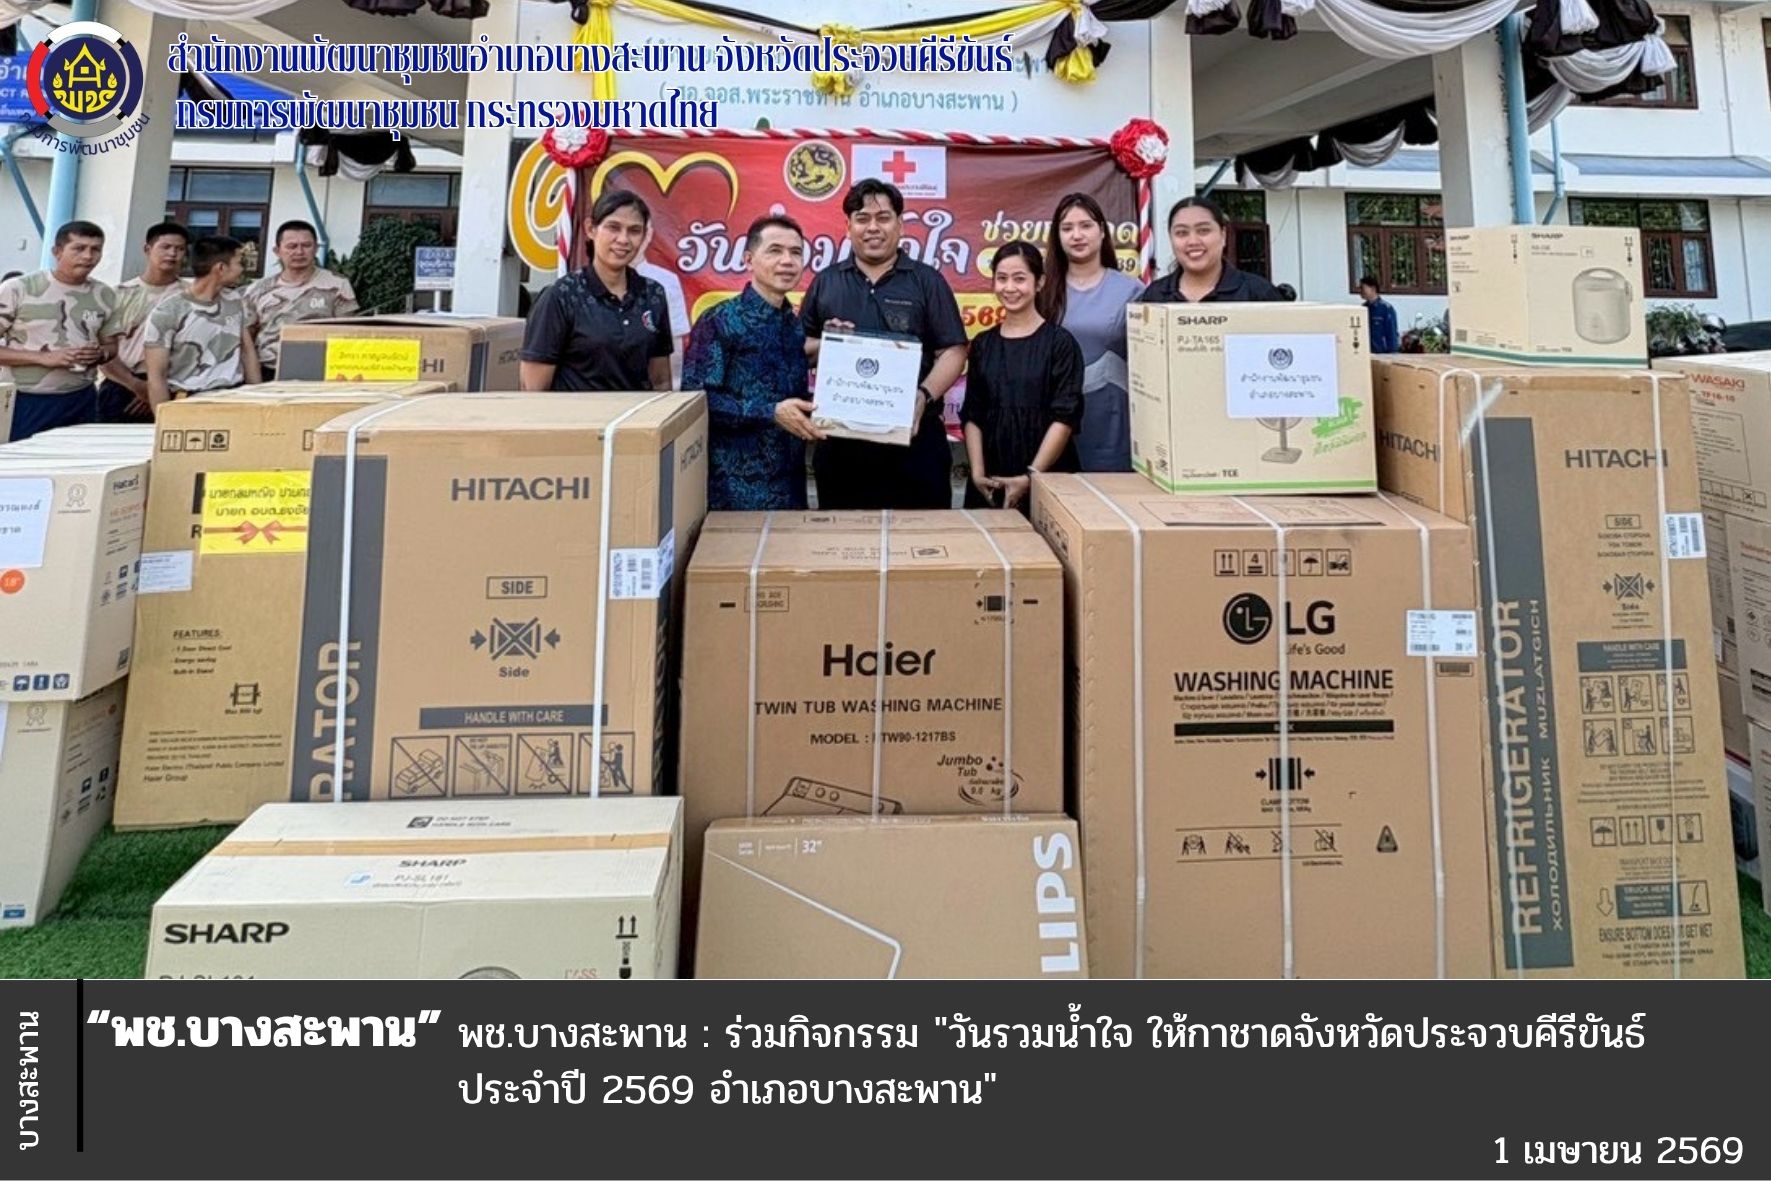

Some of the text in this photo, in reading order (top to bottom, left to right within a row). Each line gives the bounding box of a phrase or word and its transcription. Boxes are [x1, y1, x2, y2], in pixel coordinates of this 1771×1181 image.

[1177, 315, 1228, 326] SHARP
[1564, 447, 1669, 469] HITACHI
[451, 476, 590, 502] HITACHI
[501, 580, 534, 595] SIDE
[1285, 600, 1335, 636] LG
[1285, 642, 1345, 655] ife's Good
[823, 642, 936, 677] Haier
[499, 667, 530, 679] Side
[1173, 668, 1394, 693] WASHING MACHINE
[754, 698, 1003, 716] TWIN TUB WASHING MACHINE
[464, 710, 564, 724] HANDLE WITH CARE
[810, 733, 859, 745] MODEL
[872, 730, 956, 744] TW90-1217BS
[936, 754, 983, 767] Jumbo
[1494, 600, 1542, 936] REFRIGERATOR
[957, 767, 978, 777] Tub
[1541, 757, 1563, 931] ХОЛОДИЛЬНИК
[399, 859, 467, 868] SHARP
[1033, 832, 1081, 973] LIPS
[163, 921, 290, 945] SHARP
